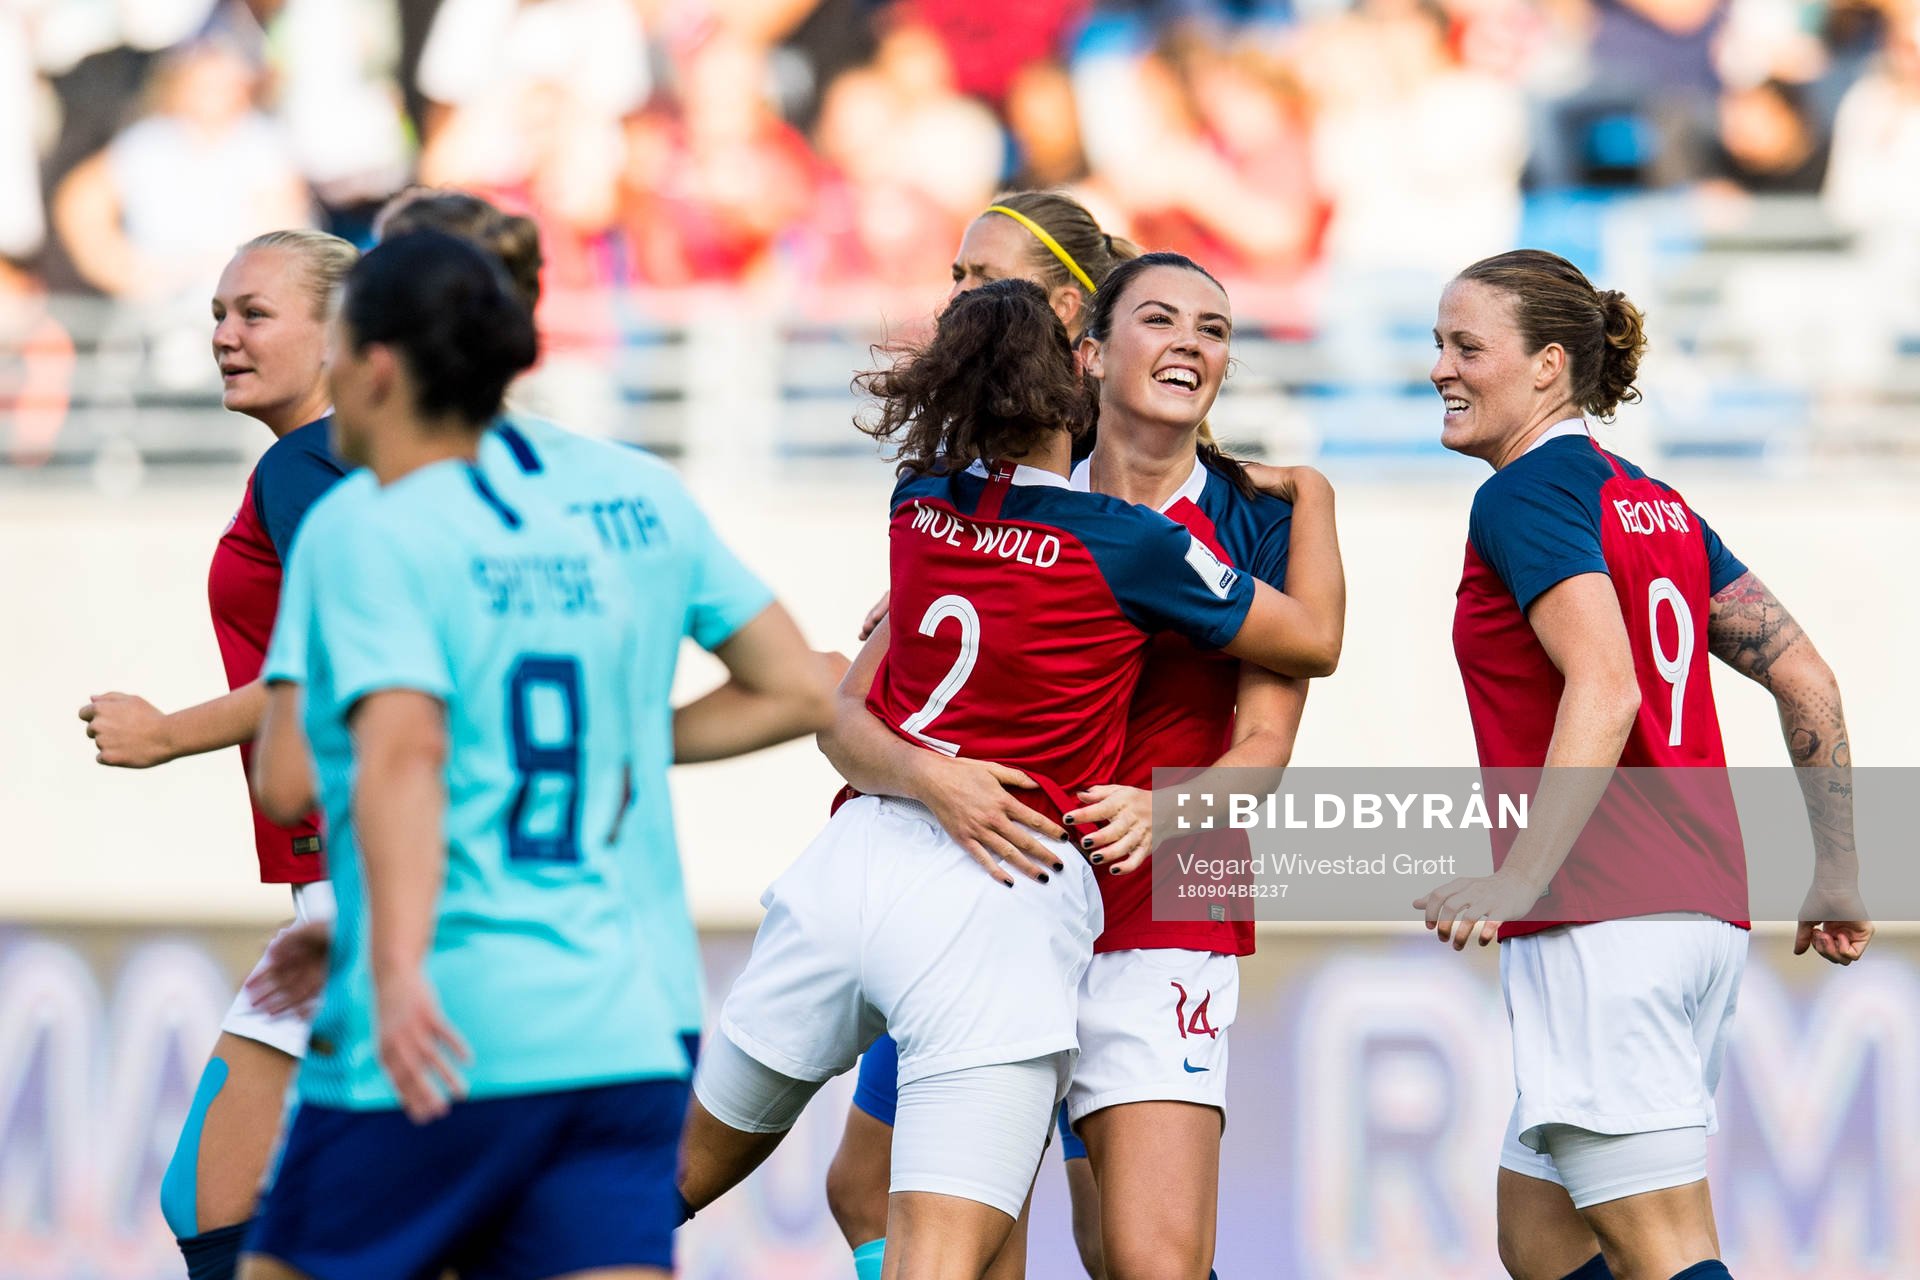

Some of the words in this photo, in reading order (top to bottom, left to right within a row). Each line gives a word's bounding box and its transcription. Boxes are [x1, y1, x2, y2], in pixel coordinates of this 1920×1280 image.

[911, 499, 964, 548] MOE
[971, 523, 1061, 568] WOLD
[899, 594, 981, 758] 2
[1648, 576, 1695, 746] 9
[505, 653, 586, 864] 8
[1170, 980, 1219, 1040] 14
